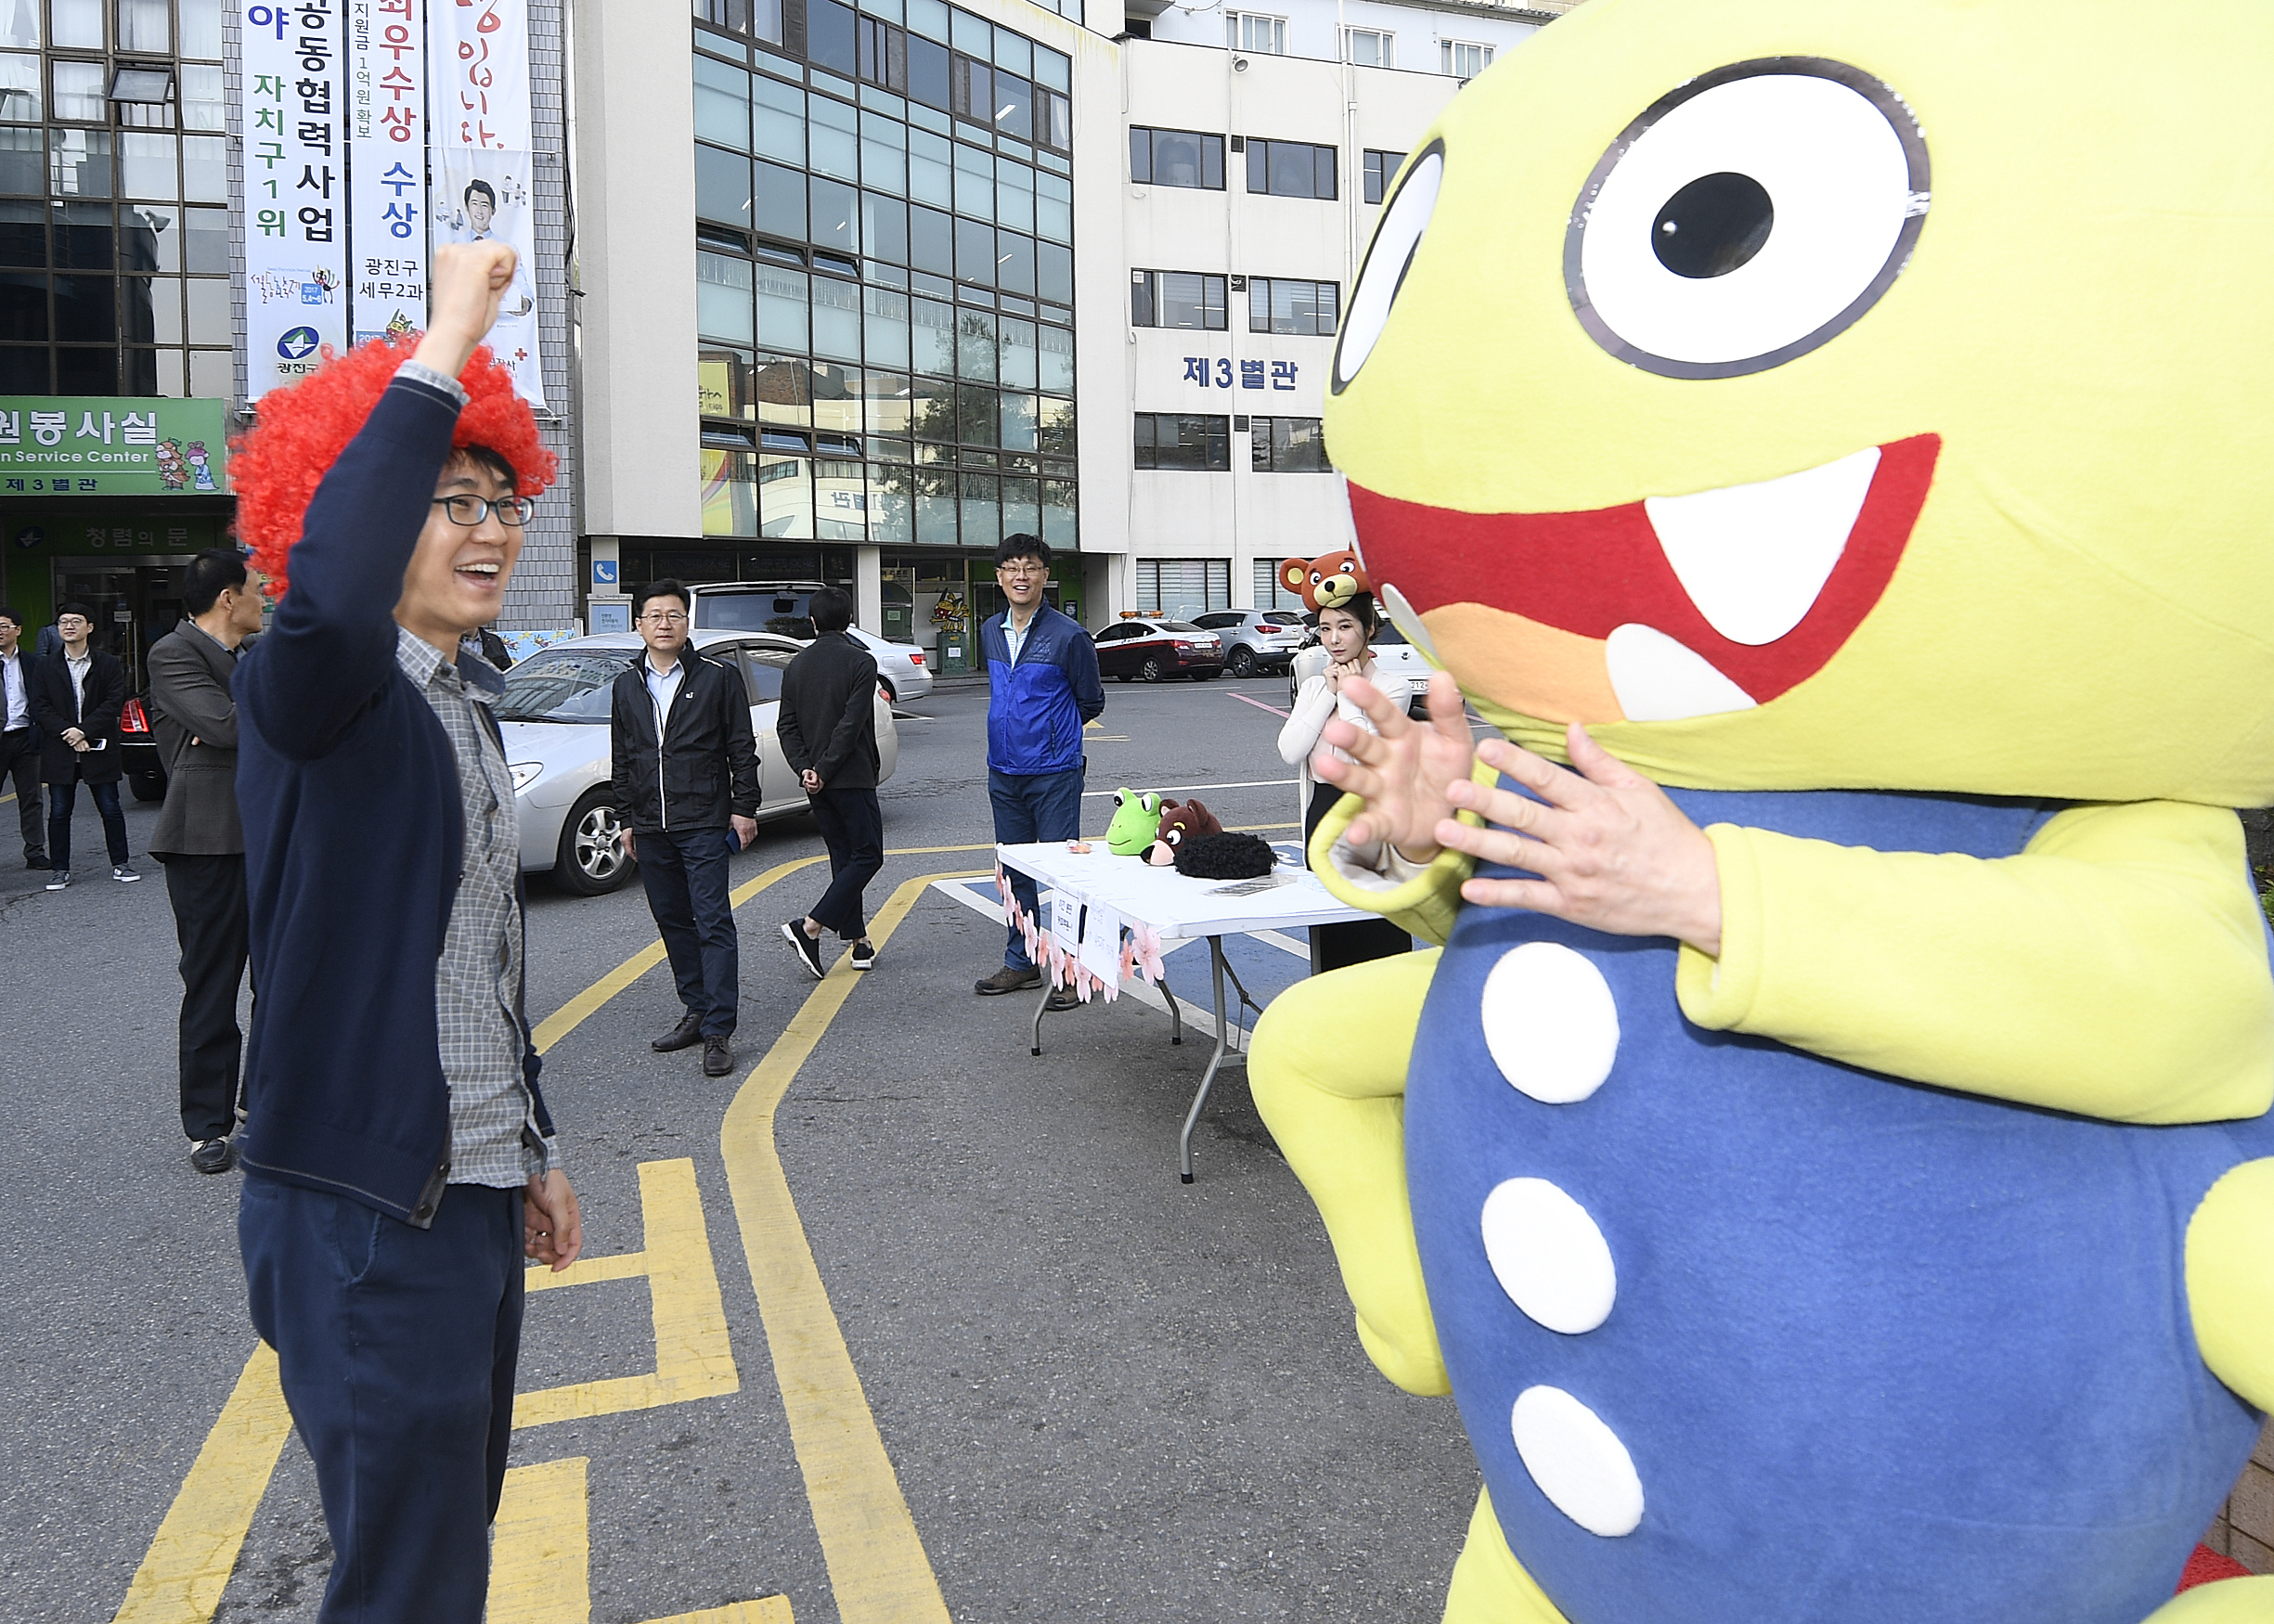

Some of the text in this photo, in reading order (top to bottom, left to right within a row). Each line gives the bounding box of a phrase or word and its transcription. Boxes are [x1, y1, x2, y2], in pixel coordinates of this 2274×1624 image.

[355, 3, 369, 50] 지원금
[381, 161, 419, 238] 수상
[365, 258, 419, 277] 광진구
[358, 281, 424, 302] 세무2과
[1183, 356, 1299, 391] 제3별관
[15, 450, 83, 463] Service
[86, 451, 149, 463] Center
[85, 527, 188, 548] 청렴의 문
